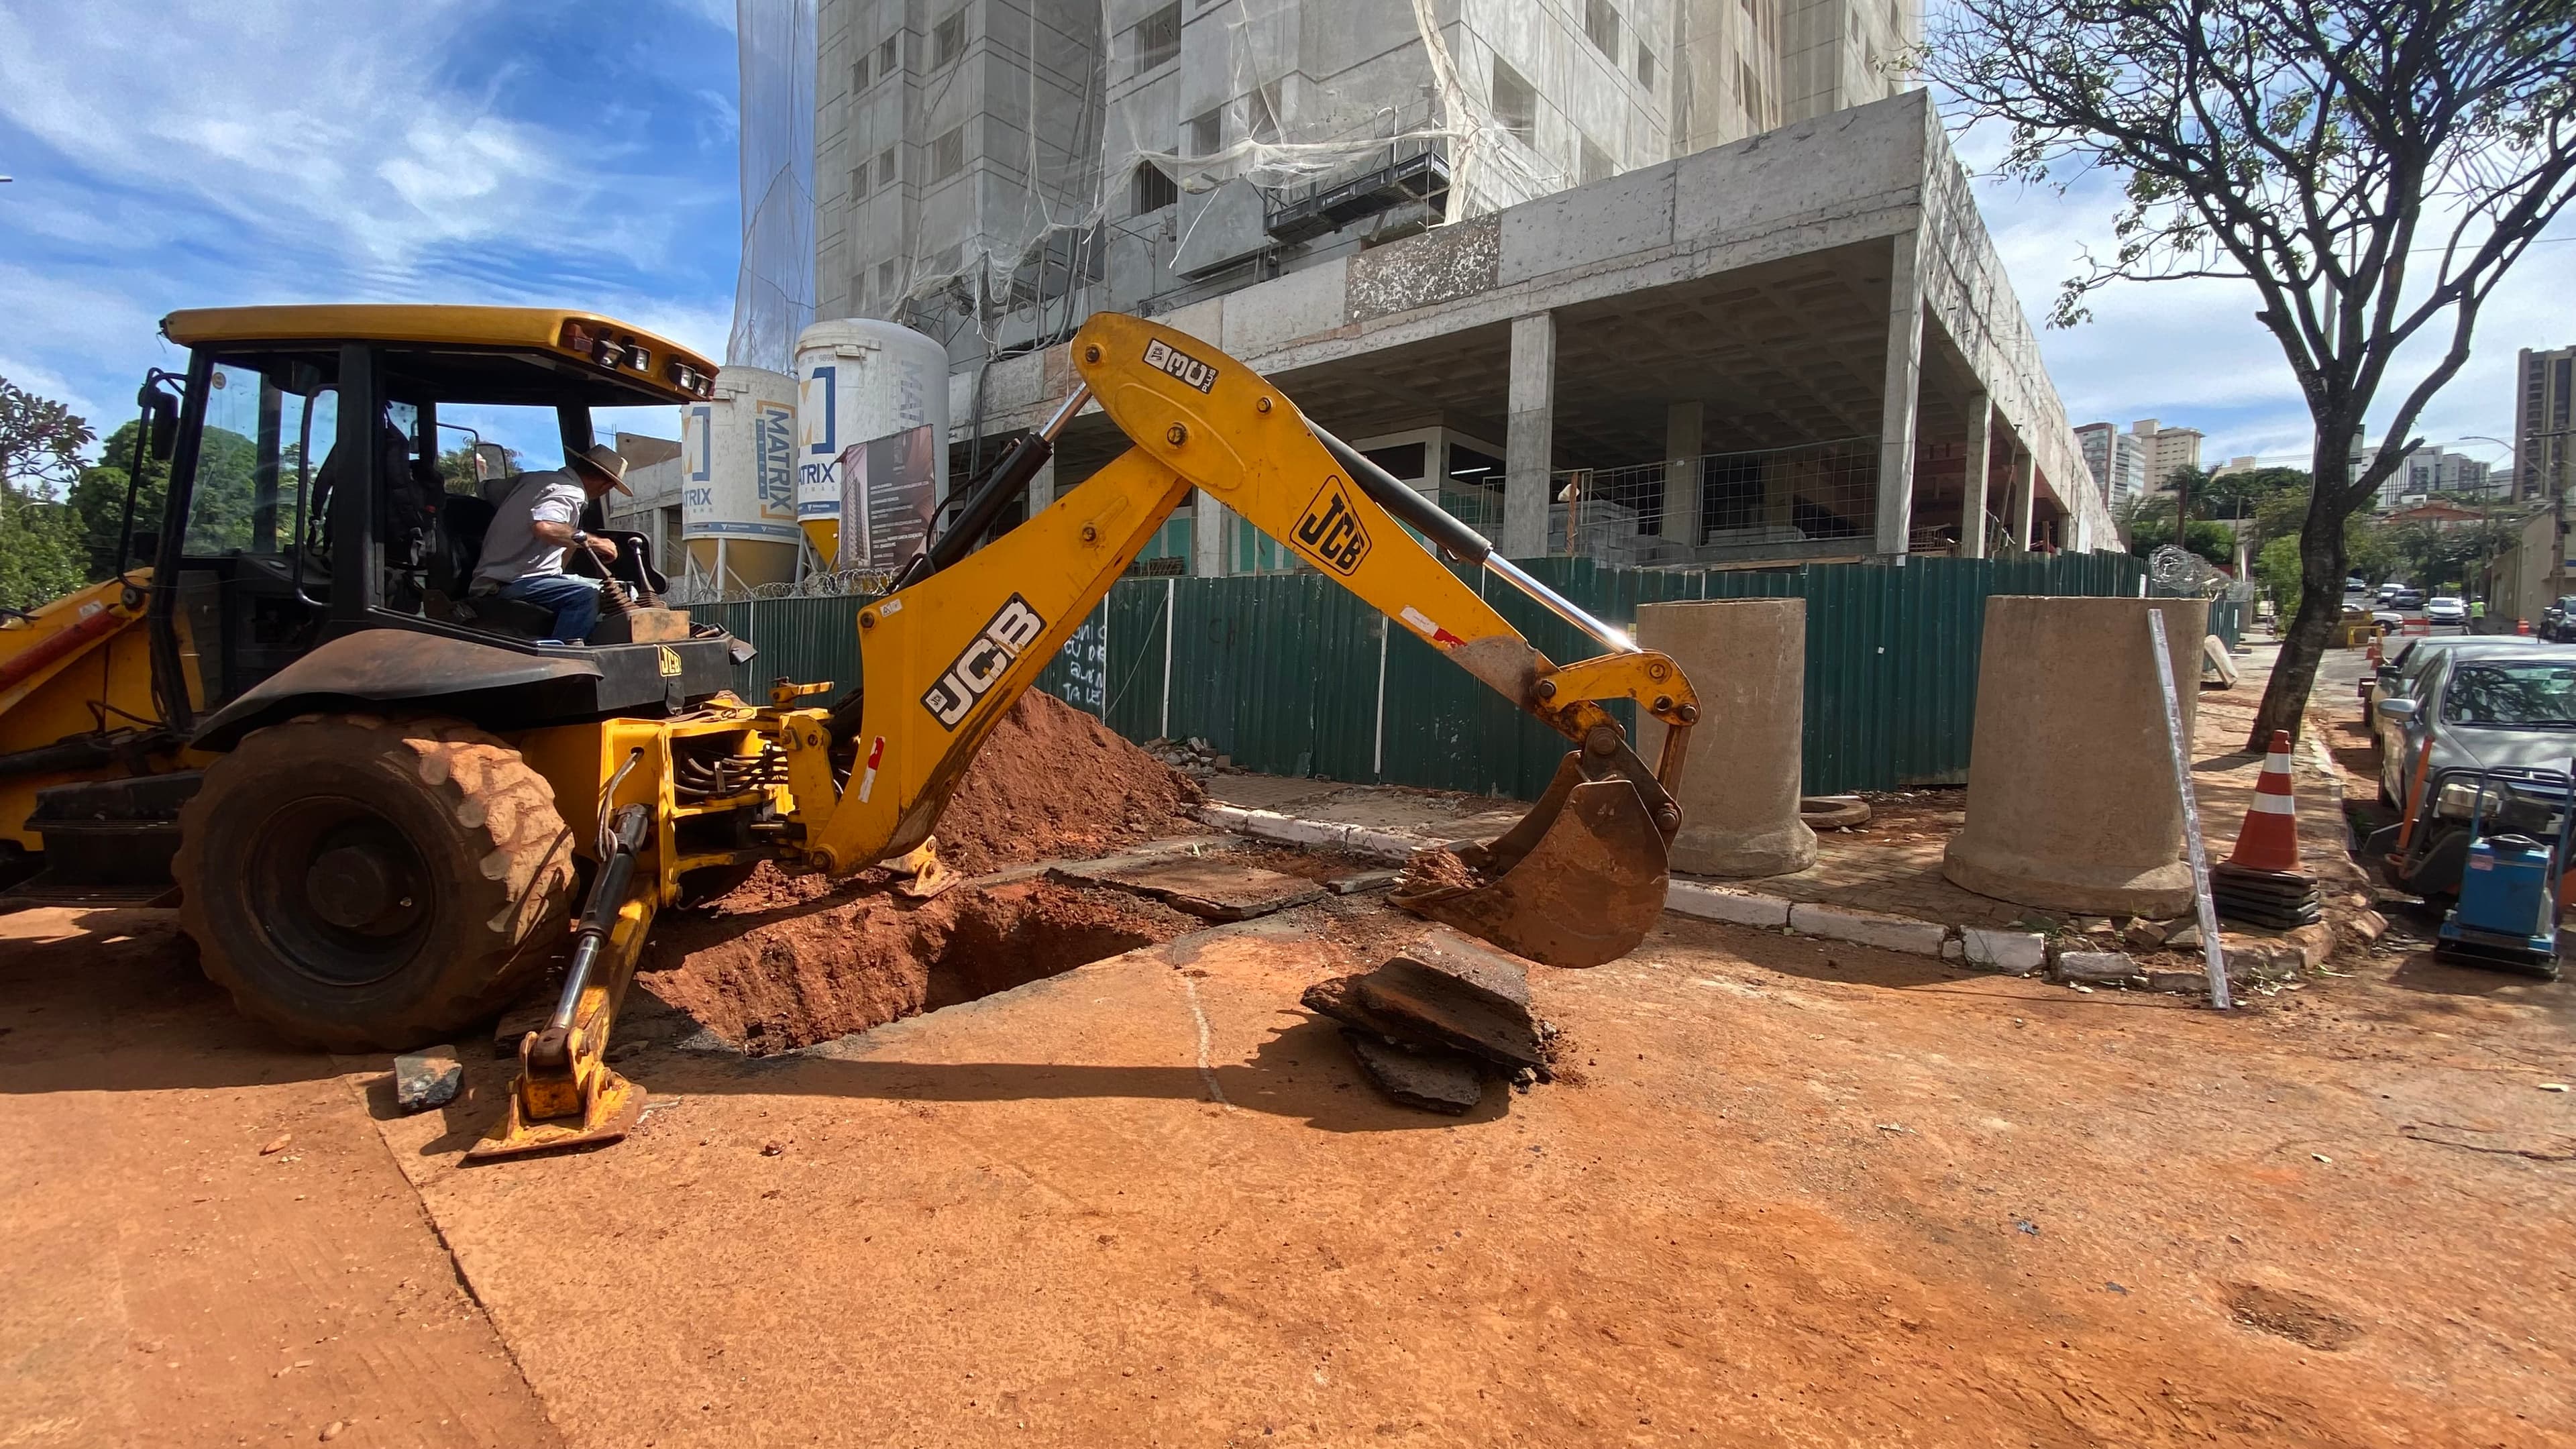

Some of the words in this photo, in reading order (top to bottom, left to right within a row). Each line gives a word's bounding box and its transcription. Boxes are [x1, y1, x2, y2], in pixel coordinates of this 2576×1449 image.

[1151, 347, 1163, 360] JCB
[1166, 352, 1208, 387] 3C
[1201, 369, 1216, 392] PLUS
[767, 409, 792, 510] MATRIX
[1297, 492, 1363, 570] JCB
[661, 646, 680, 674] JCB
[939, 600, 1041, 725] JCB
